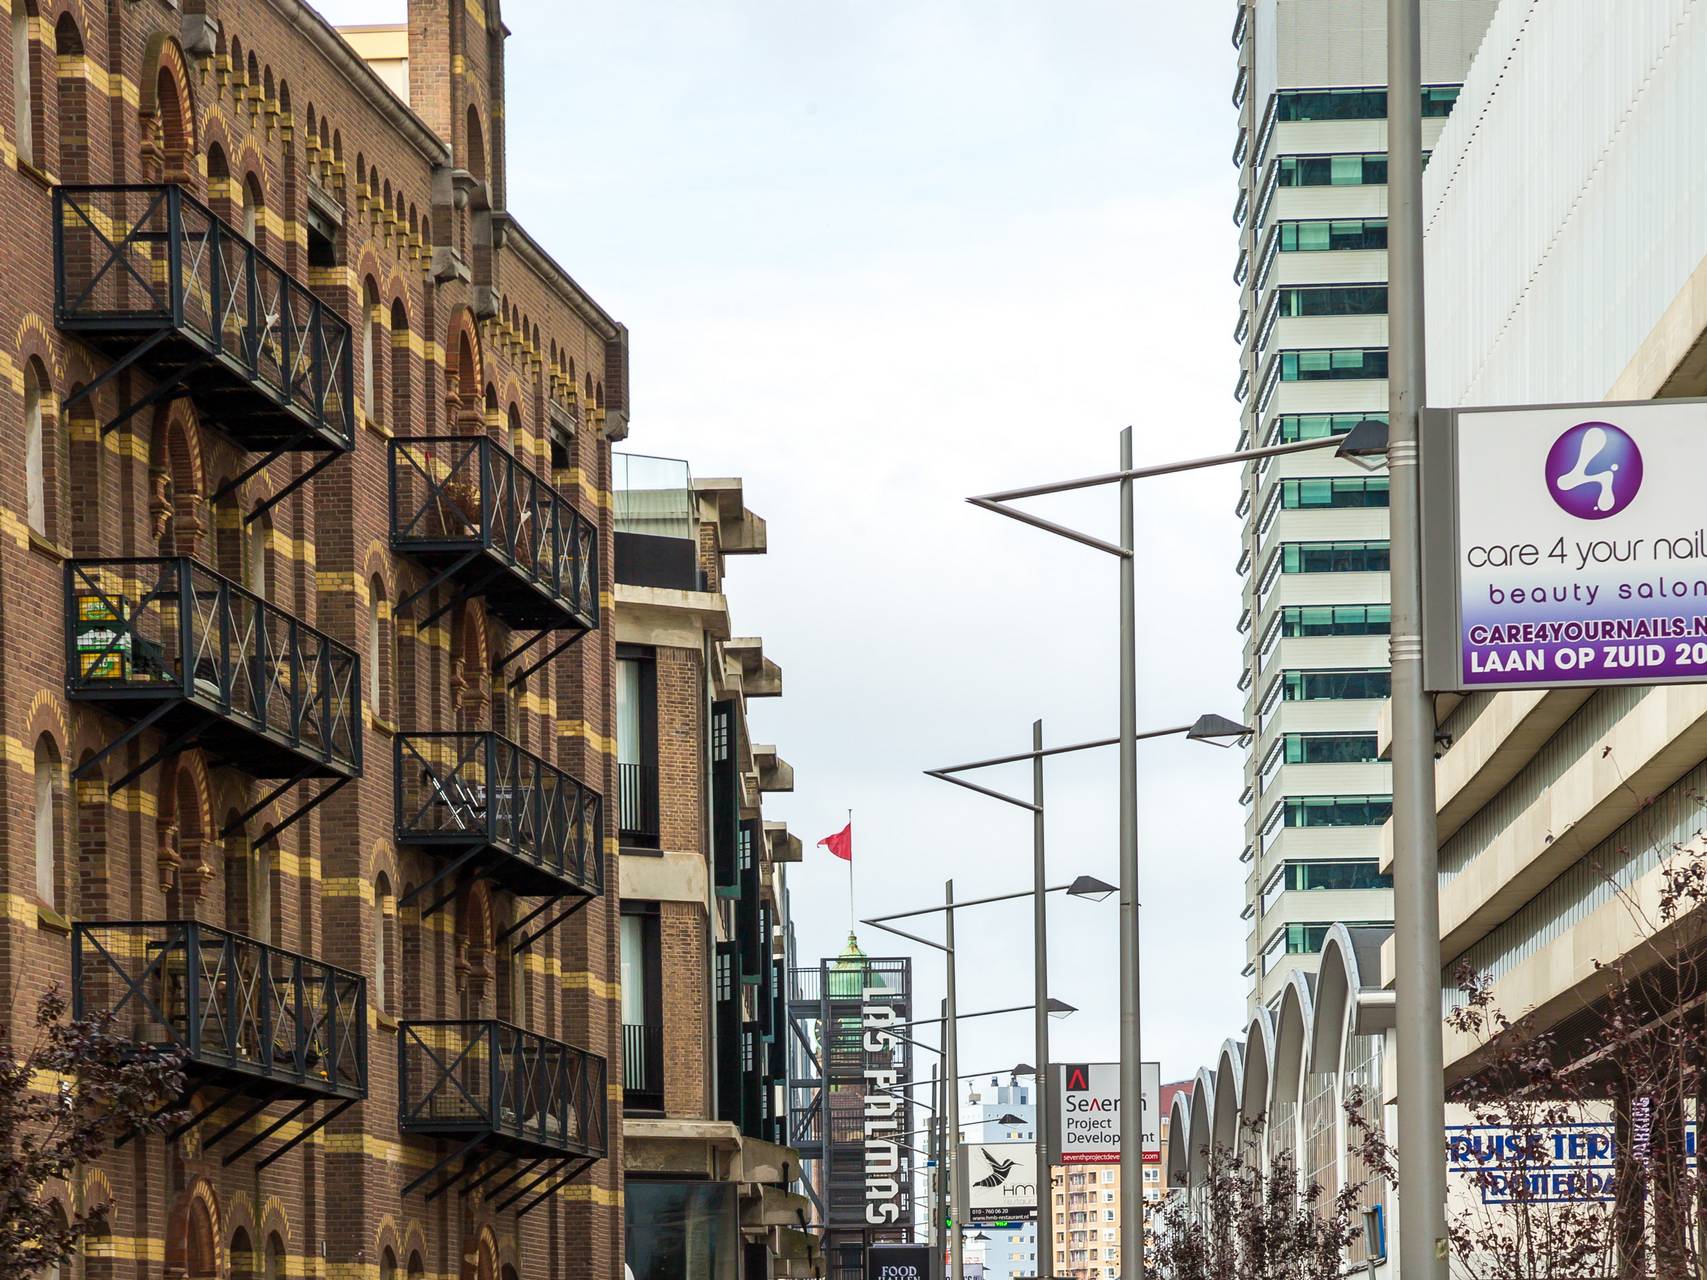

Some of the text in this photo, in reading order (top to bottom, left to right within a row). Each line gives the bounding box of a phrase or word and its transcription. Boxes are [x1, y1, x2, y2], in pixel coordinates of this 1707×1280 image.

[1467, 543, 1539, 568] care
[1547, 536, 1568, 565] 4
[1576, 537, 1645, 571] your
[1489, 576, 1707, 606] beauty salon
[1470, 650, 1546, 674] LAAN
[1554, 647, 1596, 671] OP
[1602, 645, 1666, 668] ZUID
[1067, 1117, 1112, 1132] Project
[863, 1070, 899, 1224] PALMAS
[1067, 1131, 1155, 1146] Developnt
[1450, 1134, 1546, 1161] RUISE
[1490, 1173, 1616, 1197] ROTTERDA
[882, 1266, 917, 1277] FOOD
